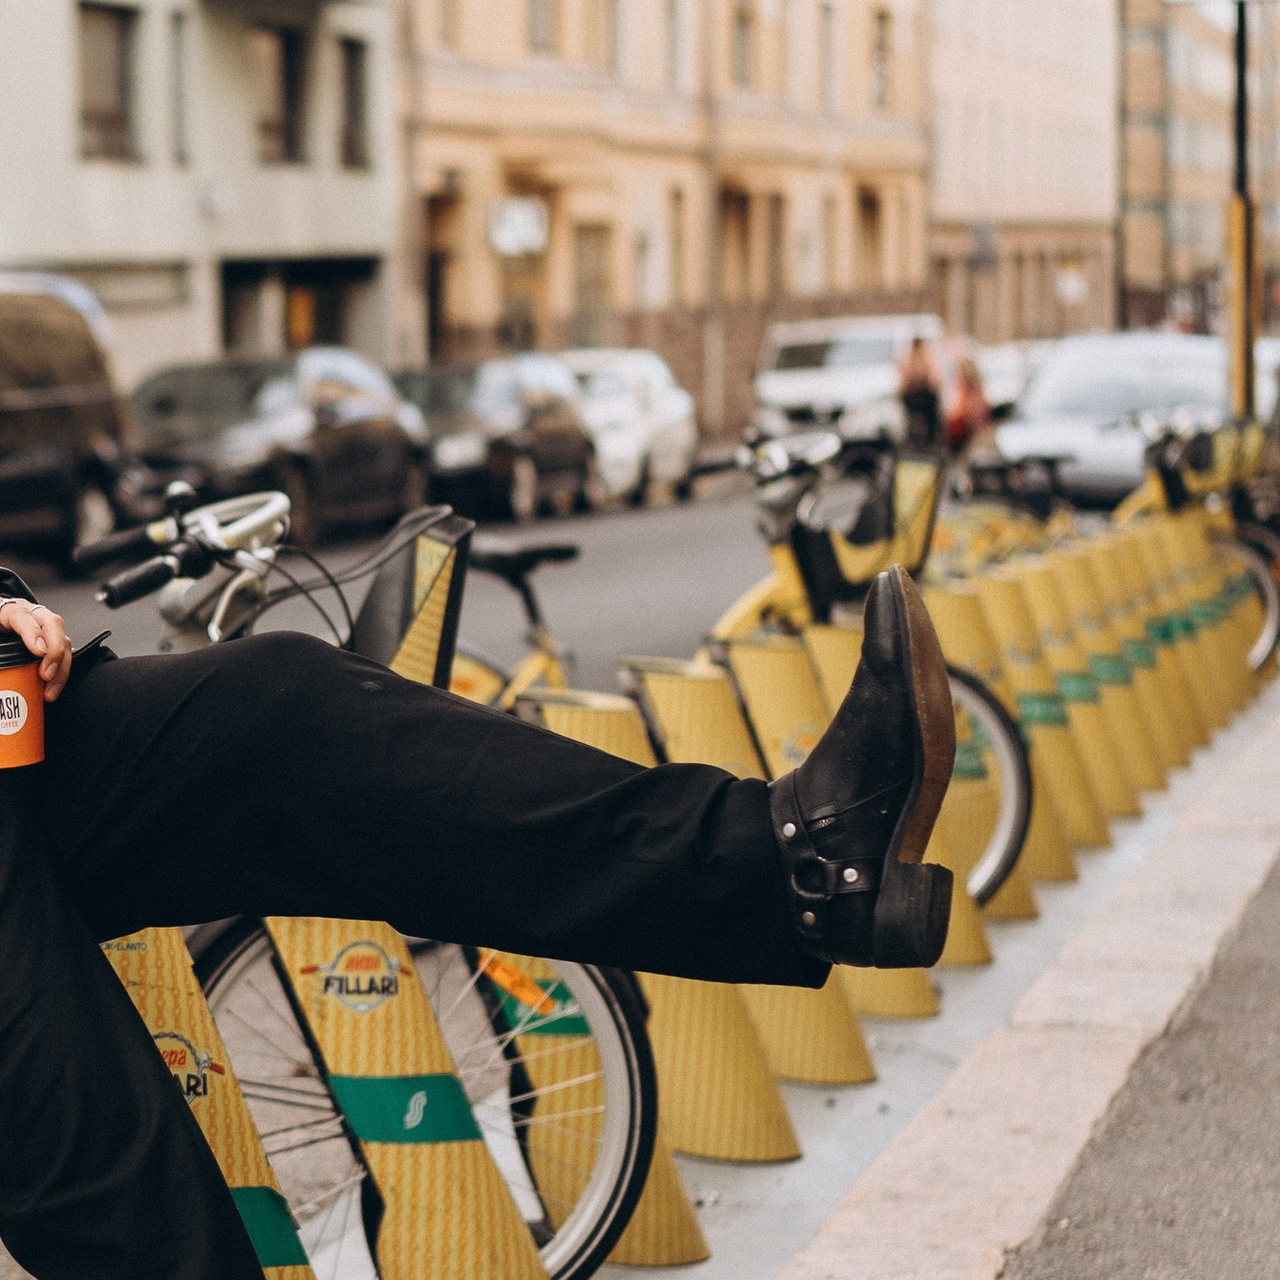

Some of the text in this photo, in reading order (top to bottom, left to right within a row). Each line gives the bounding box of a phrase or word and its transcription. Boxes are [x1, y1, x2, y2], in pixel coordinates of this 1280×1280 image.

[100, 942, 148, 951] OK-ELANTO
[323, 975, 399, 996] FILLARI
[161, 1049, 187, 1067] epa
